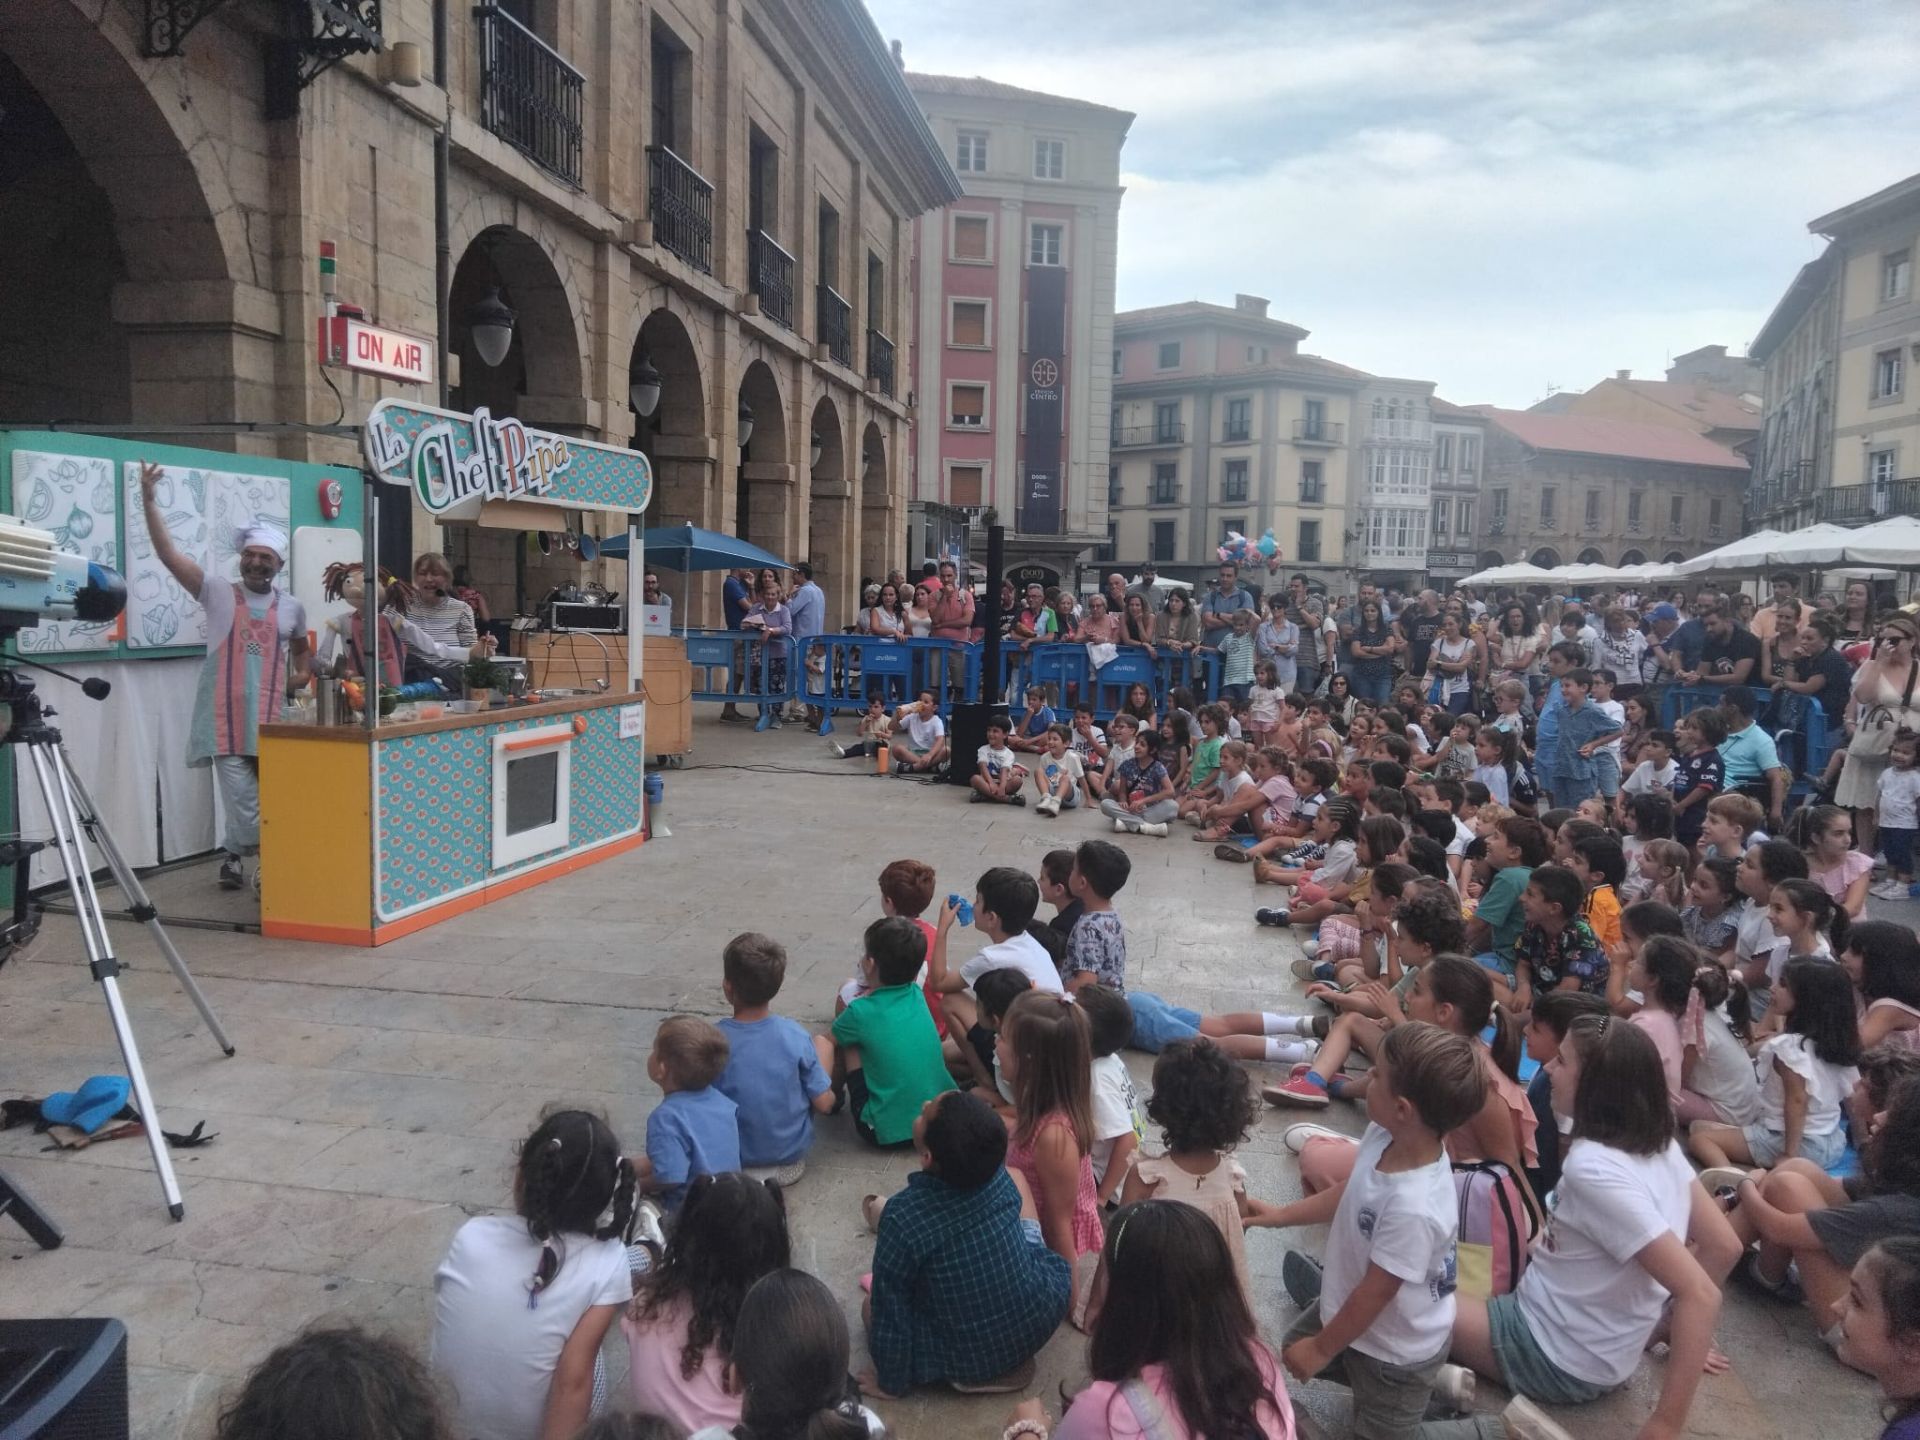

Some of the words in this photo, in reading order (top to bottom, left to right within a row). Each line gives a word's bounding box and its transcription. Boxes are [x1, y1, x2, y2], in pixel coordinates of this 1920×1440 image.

[357, 331, 383, 364] ON
[371, 419, 406, 465] La
[415, 412, 497, 511] Chef
[498, 423, 570, 496] Pipa
